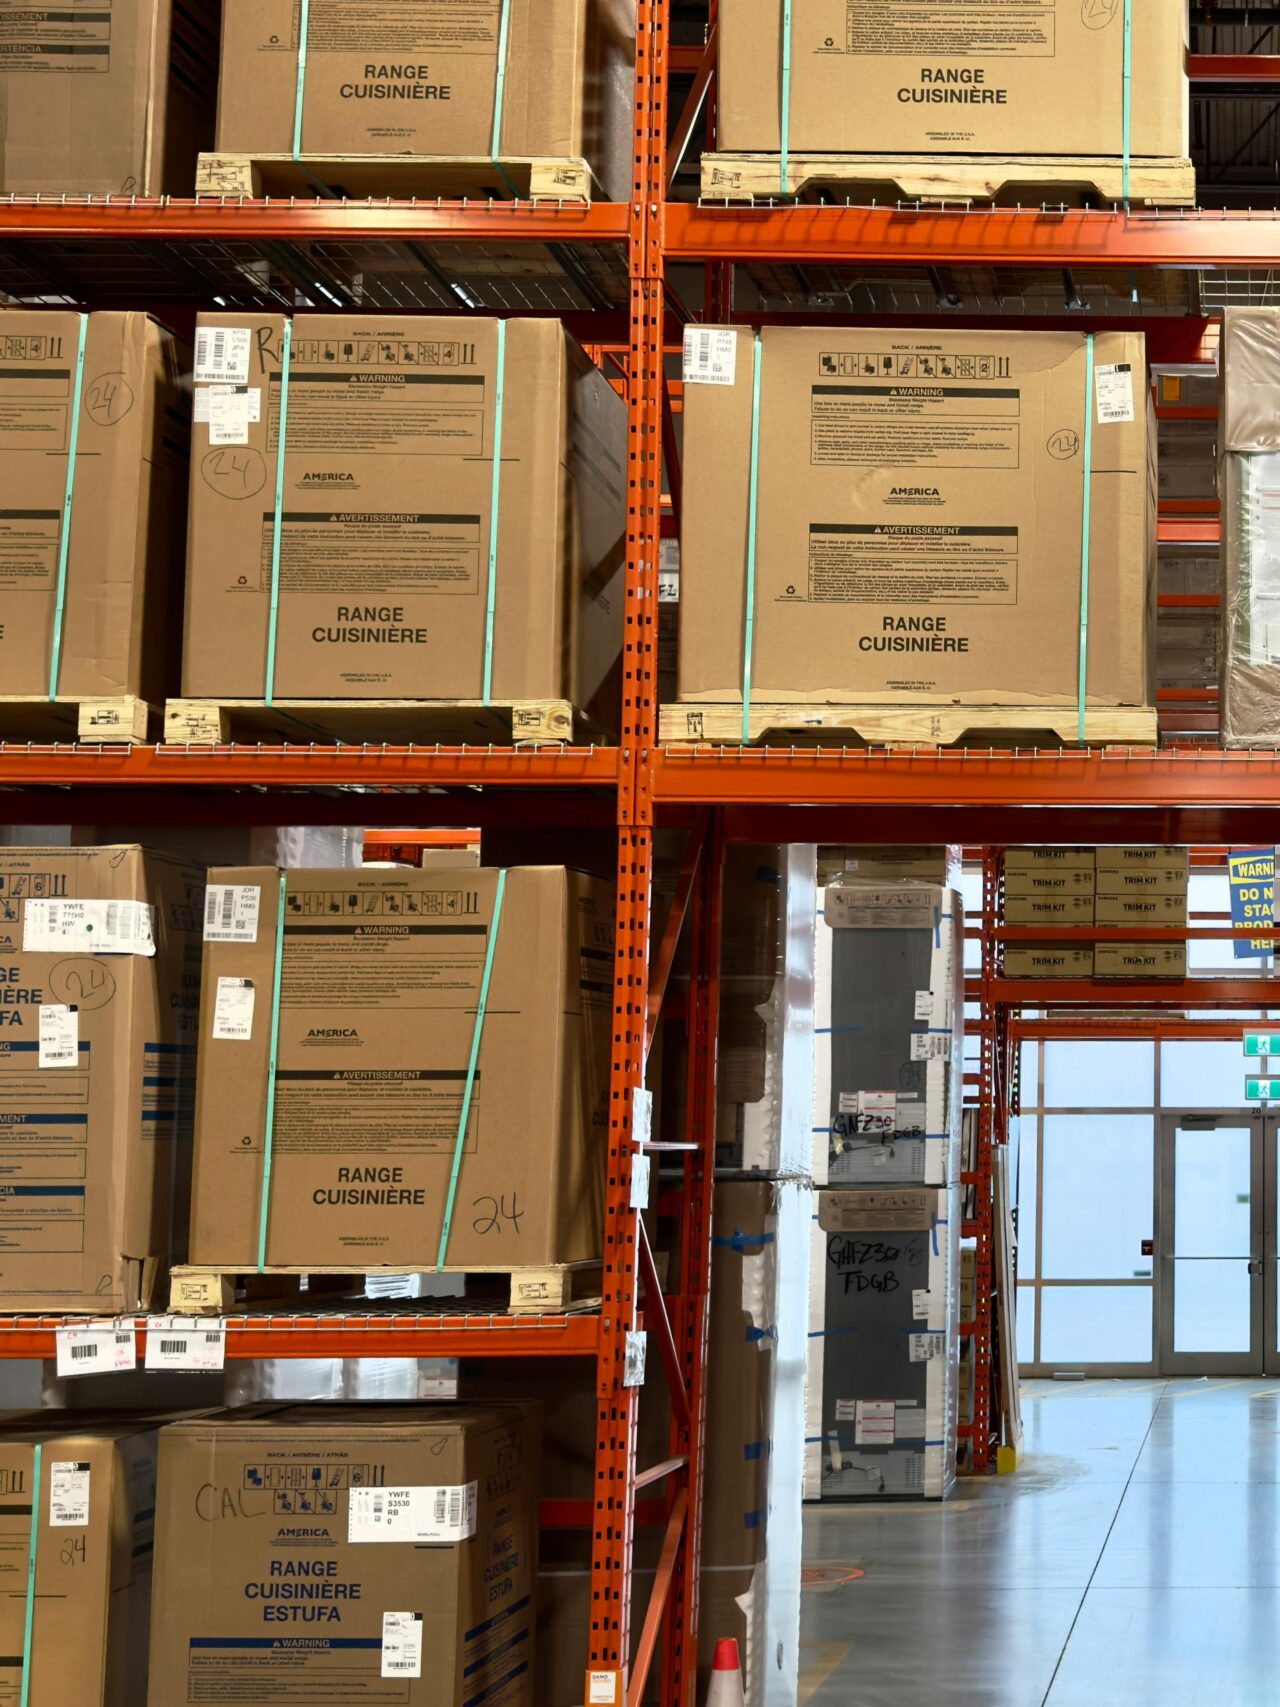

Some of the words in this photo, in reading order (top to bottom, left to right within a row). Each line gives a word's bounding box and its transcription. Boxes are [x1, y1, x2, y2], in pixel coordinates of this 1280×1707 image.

[364, 65, 429, 79] RANGE
[921, 69, 984, 84] RANGE
[340, 82, 451, 100] CUISINIÈRE
[897, 86, 1007, 104] CUISINIÈRE
[256, 326, 279, 374] R
[358, 374, 405, 383] WARNING
[899, 388, 944, 396] WARNING
[302, 472, 354, 481] AMERICA
[890, 488, 939, 496] AMERICA
[338, 514, 420, 523] AVERTISSEMENT
[337, 607, 404, 623] RANGE
[882, 616, 947, 632] RANGE
[311, 625, 428, 643] CUISINIÈRE
[858, 632, 969, 652] CUISINIÈRE
[1239, 888, 1260, 901] DO
[364, 926, 409, 934] WARNING
[1123, 957, 1142, 965] TRIM
[1143, 957, 1156, 965] KIT
[307, 1029, 358, 1038] AMERICA
[342, 1071, 422, 1080] AVERTISSEMENT
[338, 1167, 404, 1183] RANGE
[312, 1185, 425, 1206] CUISINIÈRE
[472, 1192, 525, 1234] 24
[195, 1482, 267, 1522] CAL
[278, 1528, 330, 1537] AMERICA
[60, 1535, 86, 1565] 24
[270, 1560, 338, 1577] RANGE
[244, 1580, 362, 1600] CUISINIÈRE
[263, 1605, 341, 1622] ESTUFA
[282, 1639, 330, 1648] WARNING
